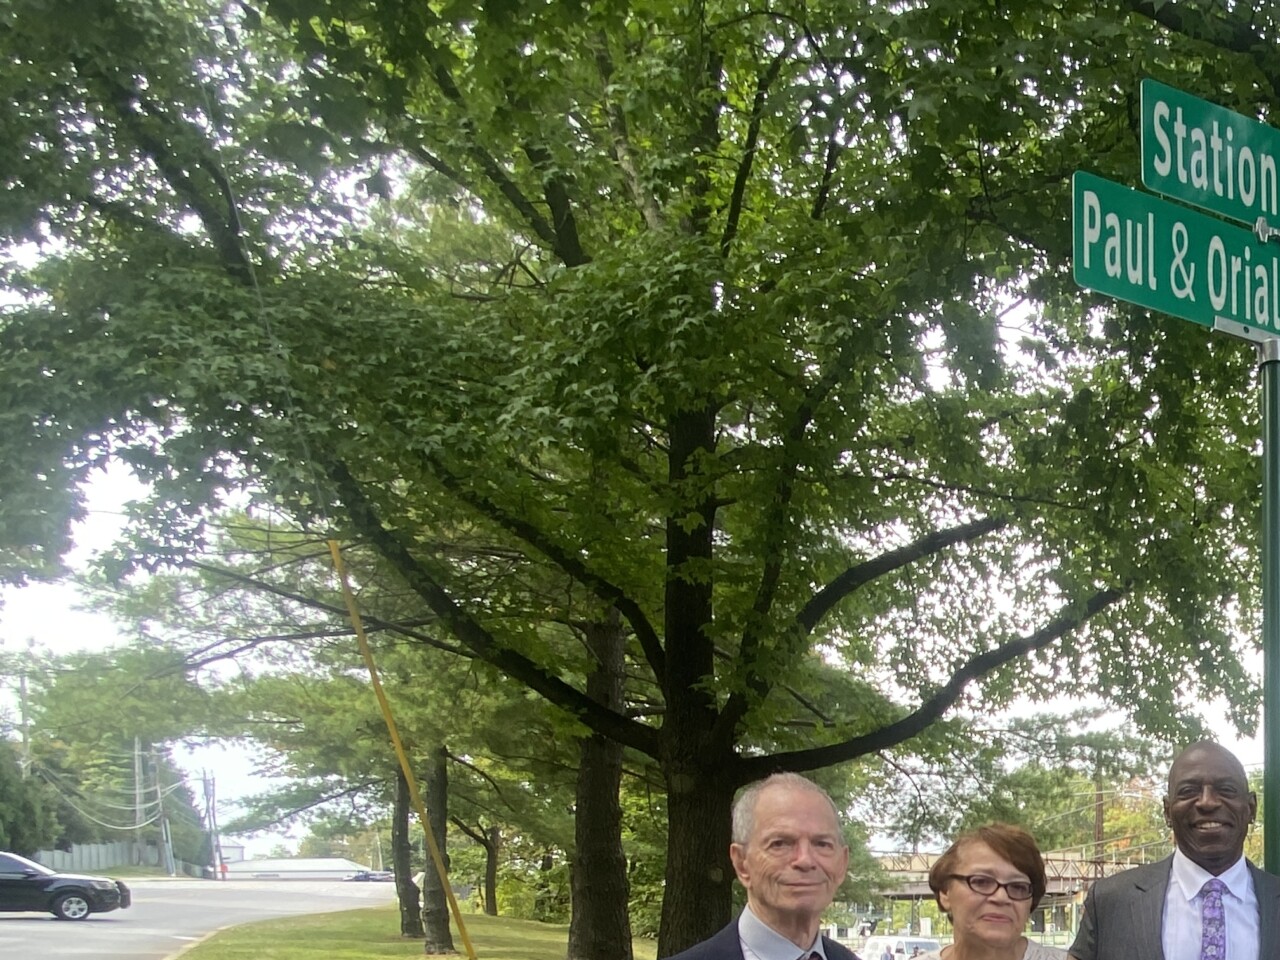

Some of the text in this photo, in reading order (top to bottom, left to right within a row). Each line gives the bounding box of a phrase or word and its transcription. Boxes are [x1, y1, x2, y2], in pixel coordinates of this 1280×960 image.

[1153, 100, 1278, 216] Station
[1083, 190, 1157, 291] Paul
[1170, 221, 1196, 303] &
[1207, 234, 1280, 331] Orial
